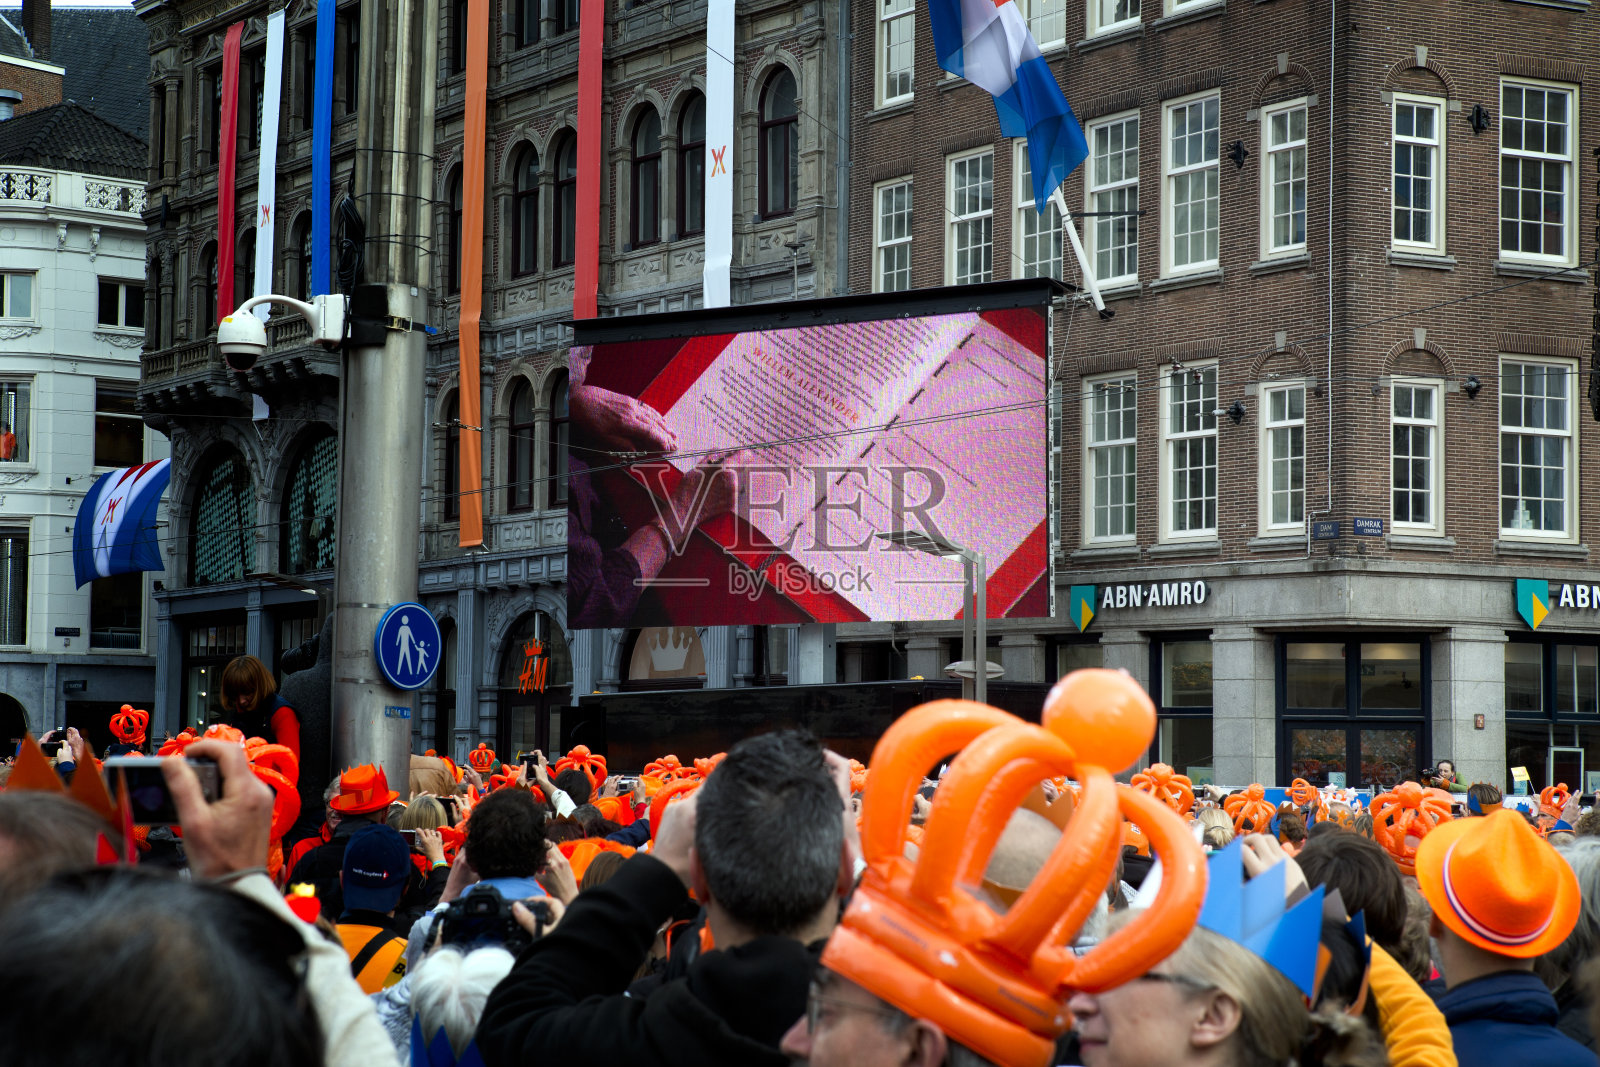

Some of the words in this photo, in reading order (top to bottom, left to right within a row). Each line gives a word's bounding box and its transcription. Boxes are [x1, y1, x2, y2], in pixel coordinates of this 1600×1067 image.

[1320, 524, 1333, 532] DAM
[1356, 519, 1381, 529] DAMRAK
[518, 656, 548, 695] H&M
